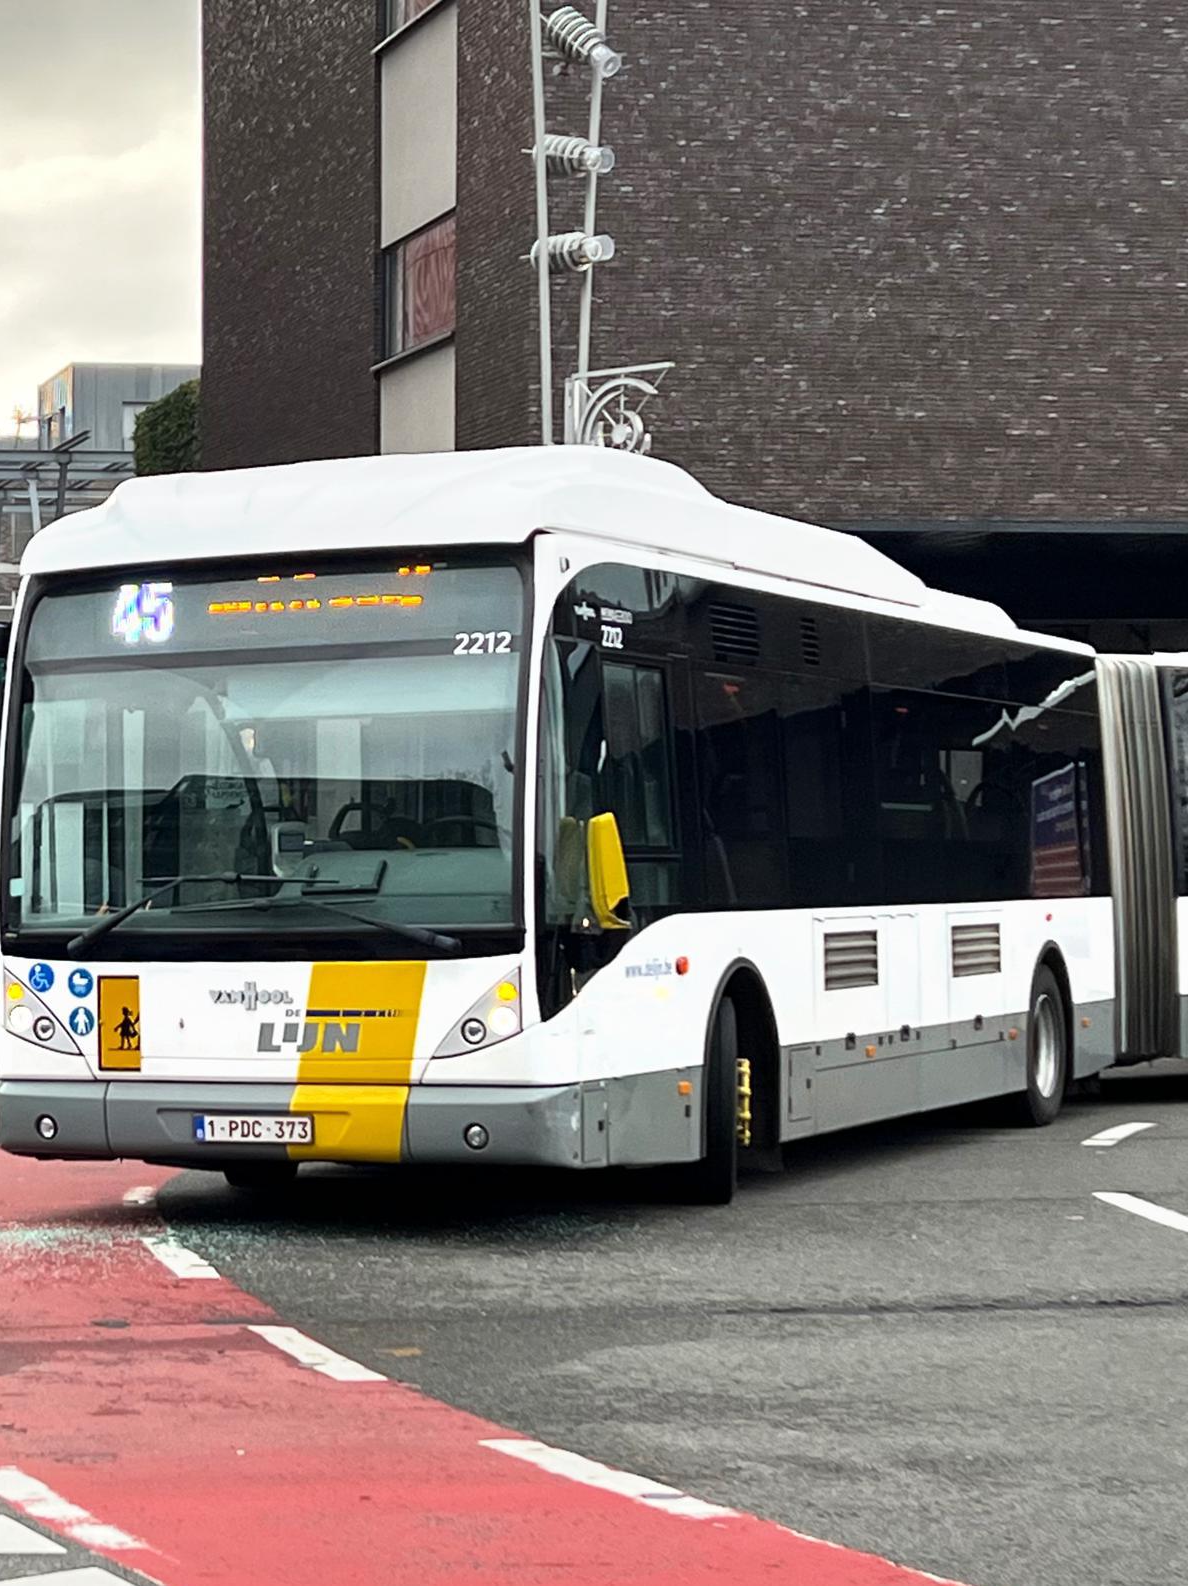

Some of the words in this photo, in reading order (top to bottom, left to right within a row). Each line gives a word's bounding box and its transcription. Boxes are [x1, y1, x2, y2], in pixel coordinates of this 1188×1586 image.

[113, 582, 175, 643] 45
[453, 631, 512, 656] 2212
[601, 625, 624, 650] 2212
[285, 1008, 301, 1018] DE
[257, 1022, 362, 1053] LIJN
